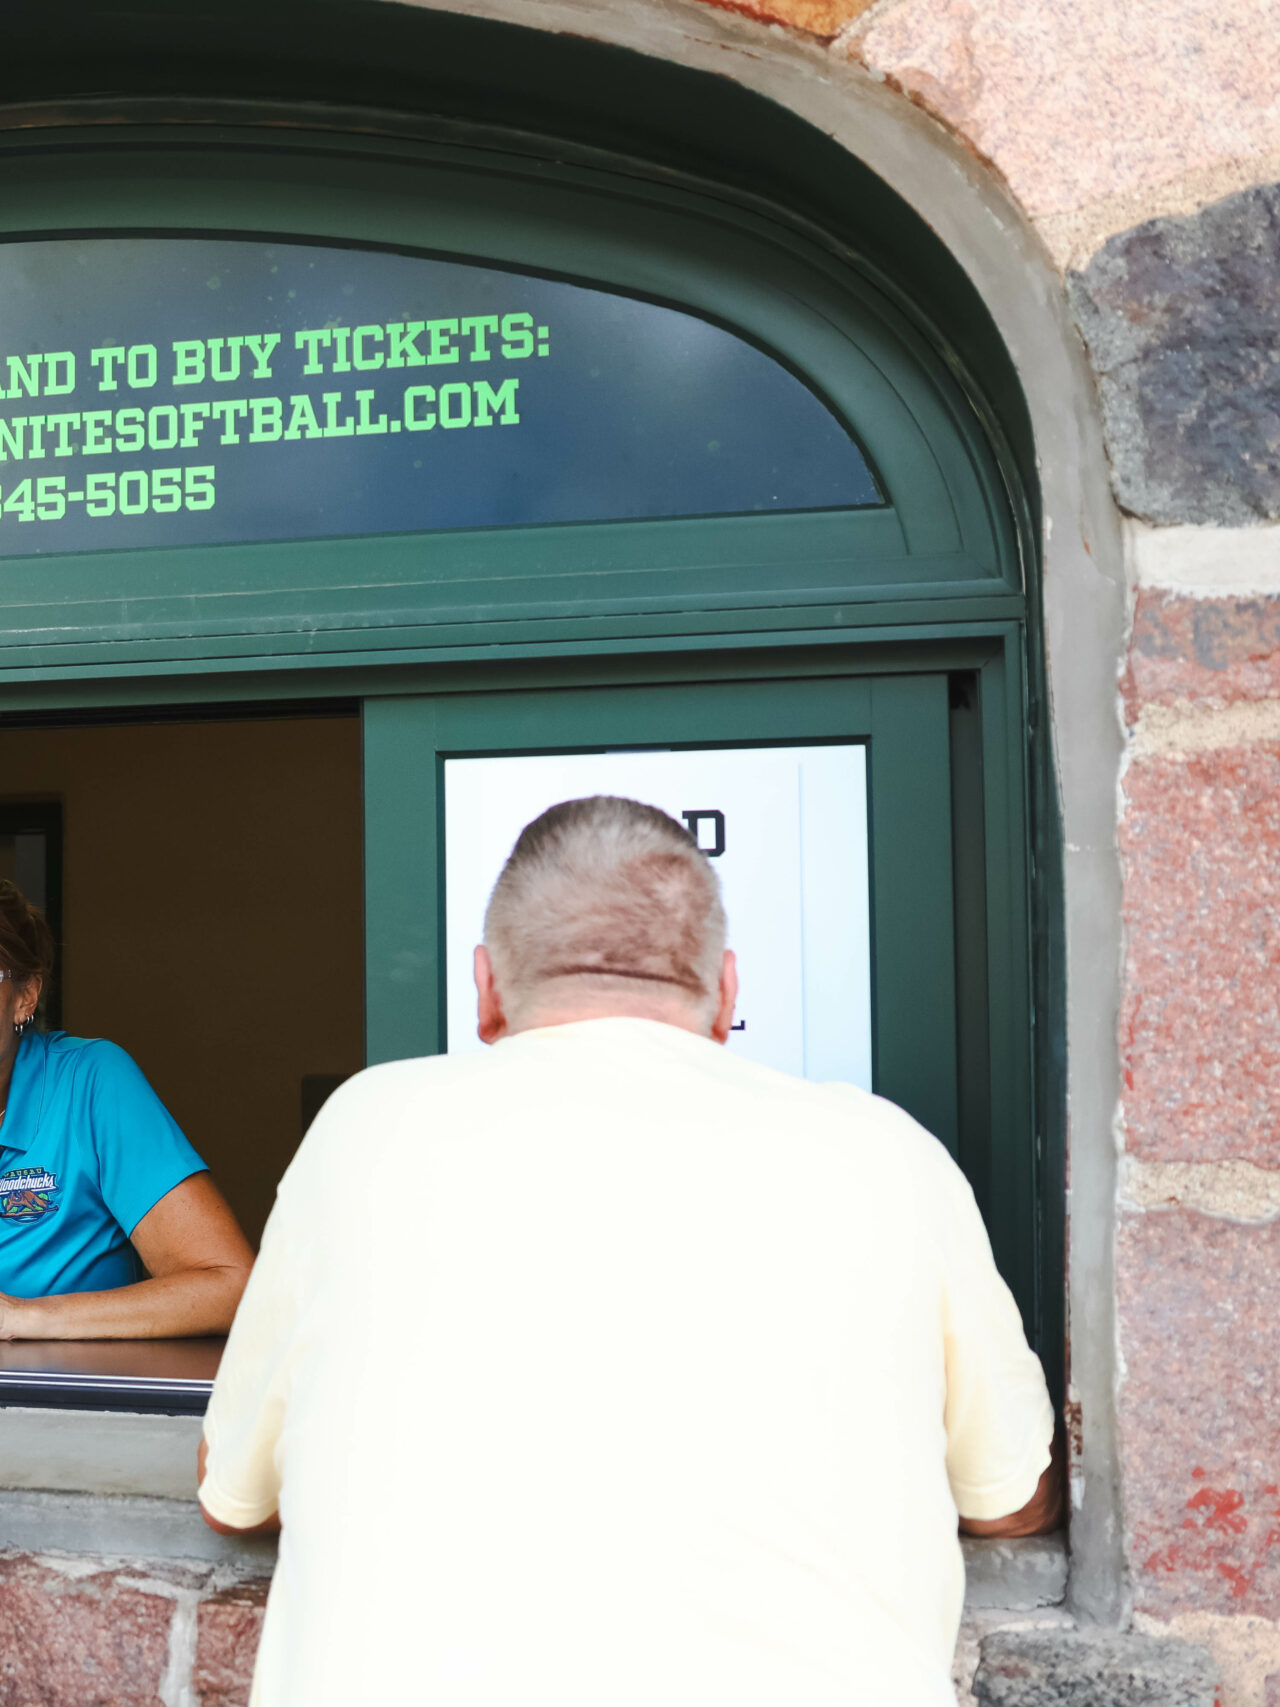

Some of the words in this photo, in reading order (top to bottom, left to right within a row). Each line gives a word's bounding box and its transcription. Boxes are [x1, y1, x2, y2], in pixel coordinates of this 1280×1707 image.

[90, 344, 158, 391] TO
[172, 333, 281, 385] BUY
[294, 312, 550, 375] TICKETS:
